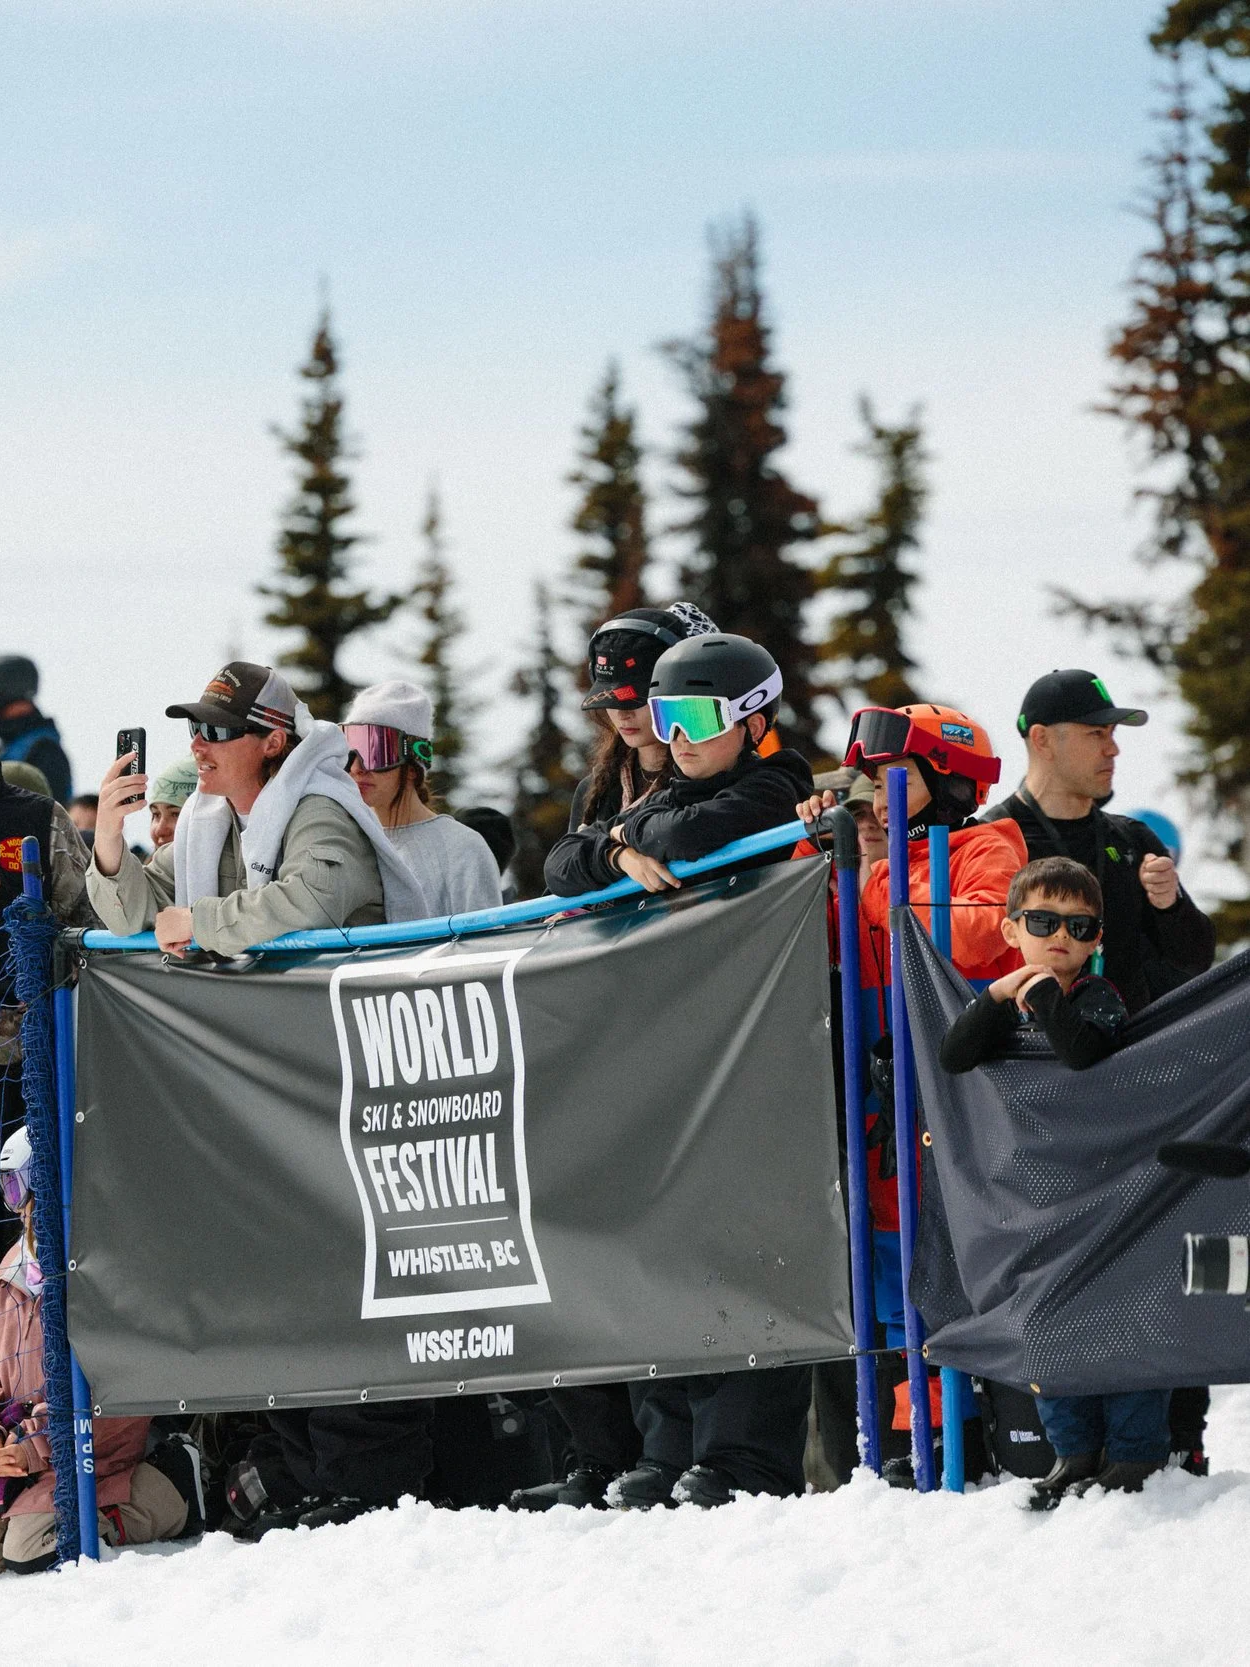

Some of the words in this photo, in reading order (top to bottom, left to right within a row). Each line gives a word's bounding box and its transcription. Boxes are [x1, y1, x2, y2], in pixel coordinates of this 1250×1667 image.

[908, 823, 926, 838] UTU
[351, 981, 499, 1089] WORLD
[361, 1103, 388, 1133] SKI
[391, 1102, 403, 1130] &
[407, 1090, 502, 1127] SNOWBOARD
[363, 1132, 506, 1214] FESTIVAL
[387, 1243, 492, 1278] WHISTLER,
[490, 1239, 521, 1267] BC
[406, 1324, 514, 1364] WSSF.COM
